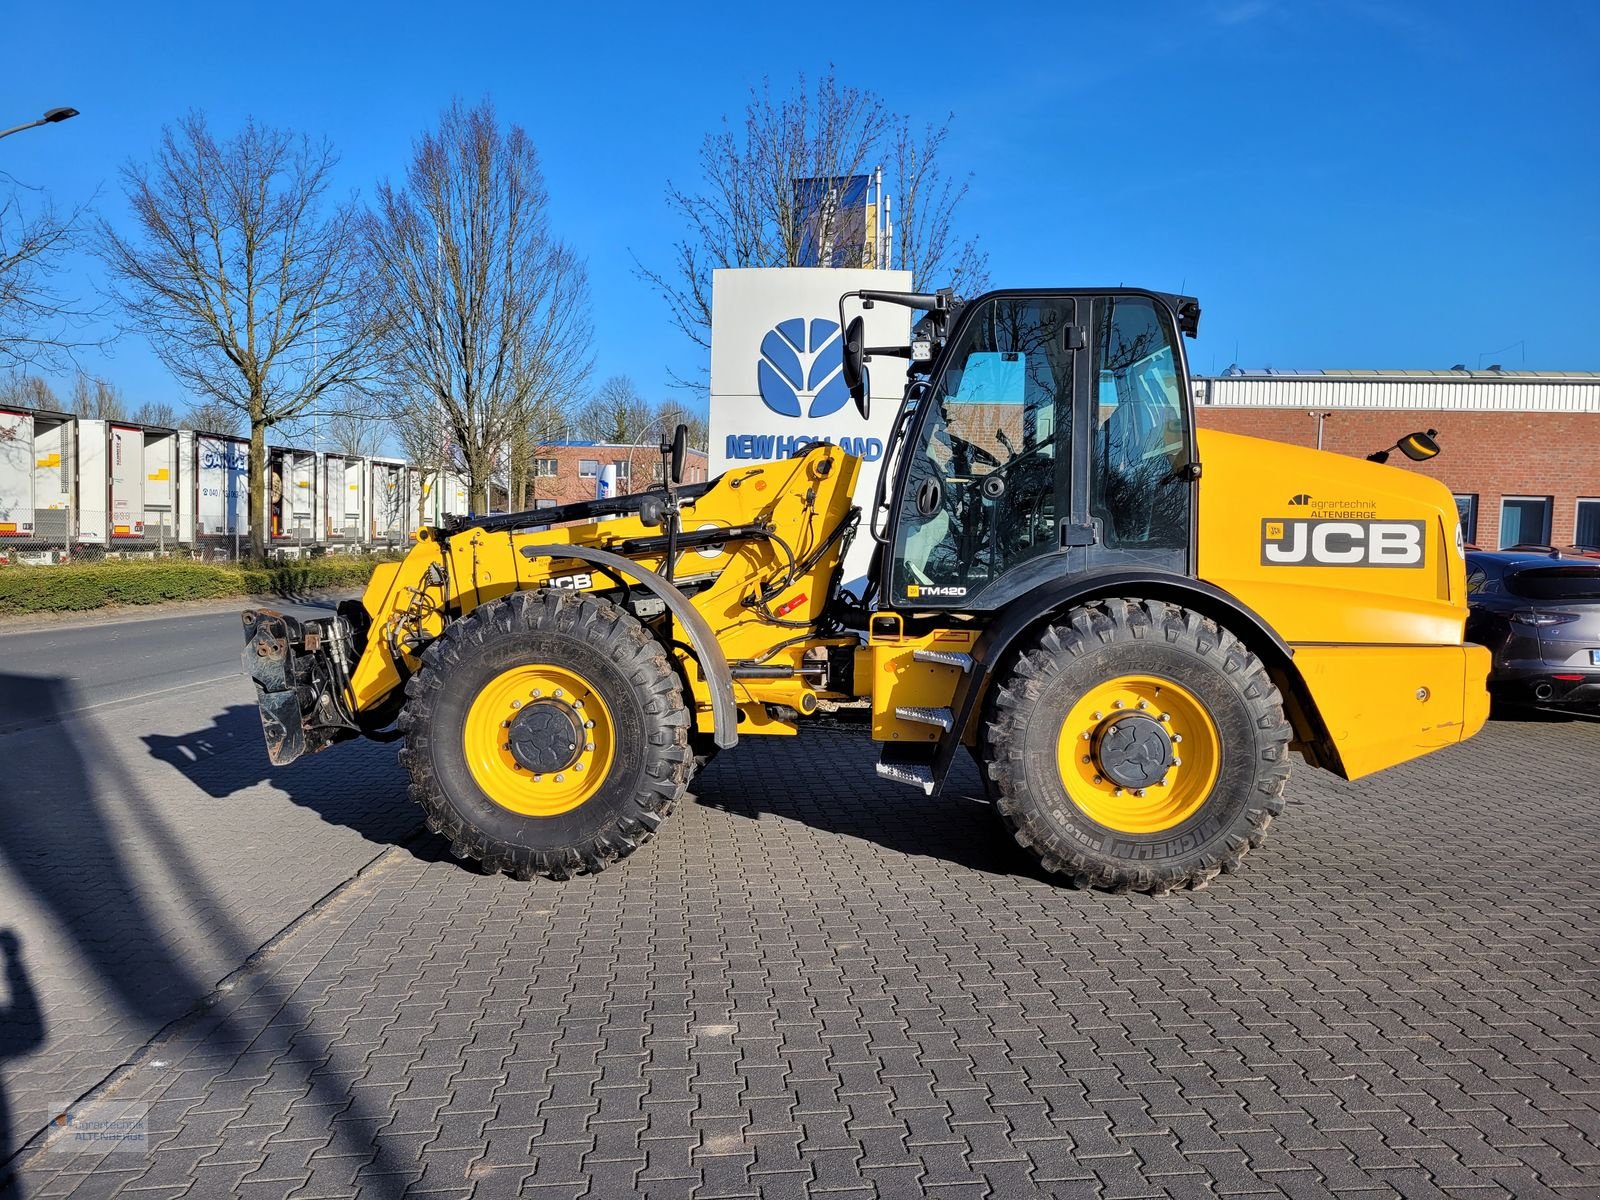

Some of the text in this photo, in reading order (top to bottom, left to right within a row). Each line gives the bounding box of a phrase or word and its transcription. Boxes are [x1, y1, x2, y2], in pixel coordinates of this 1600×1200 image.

[725, 434, 884, 462] NEW HOAND
[1310, 511, 1377, 519] ALTENBERGE
[1311, 500, 1377, 510] agrartechnik
[1265, 522, 1422, 564] JCB
[919, 586, 967, 596] TM420
[1052, 808, 1103, 851] BIBLOAD
[1109, 816, 1225, 862] MICHELIN
